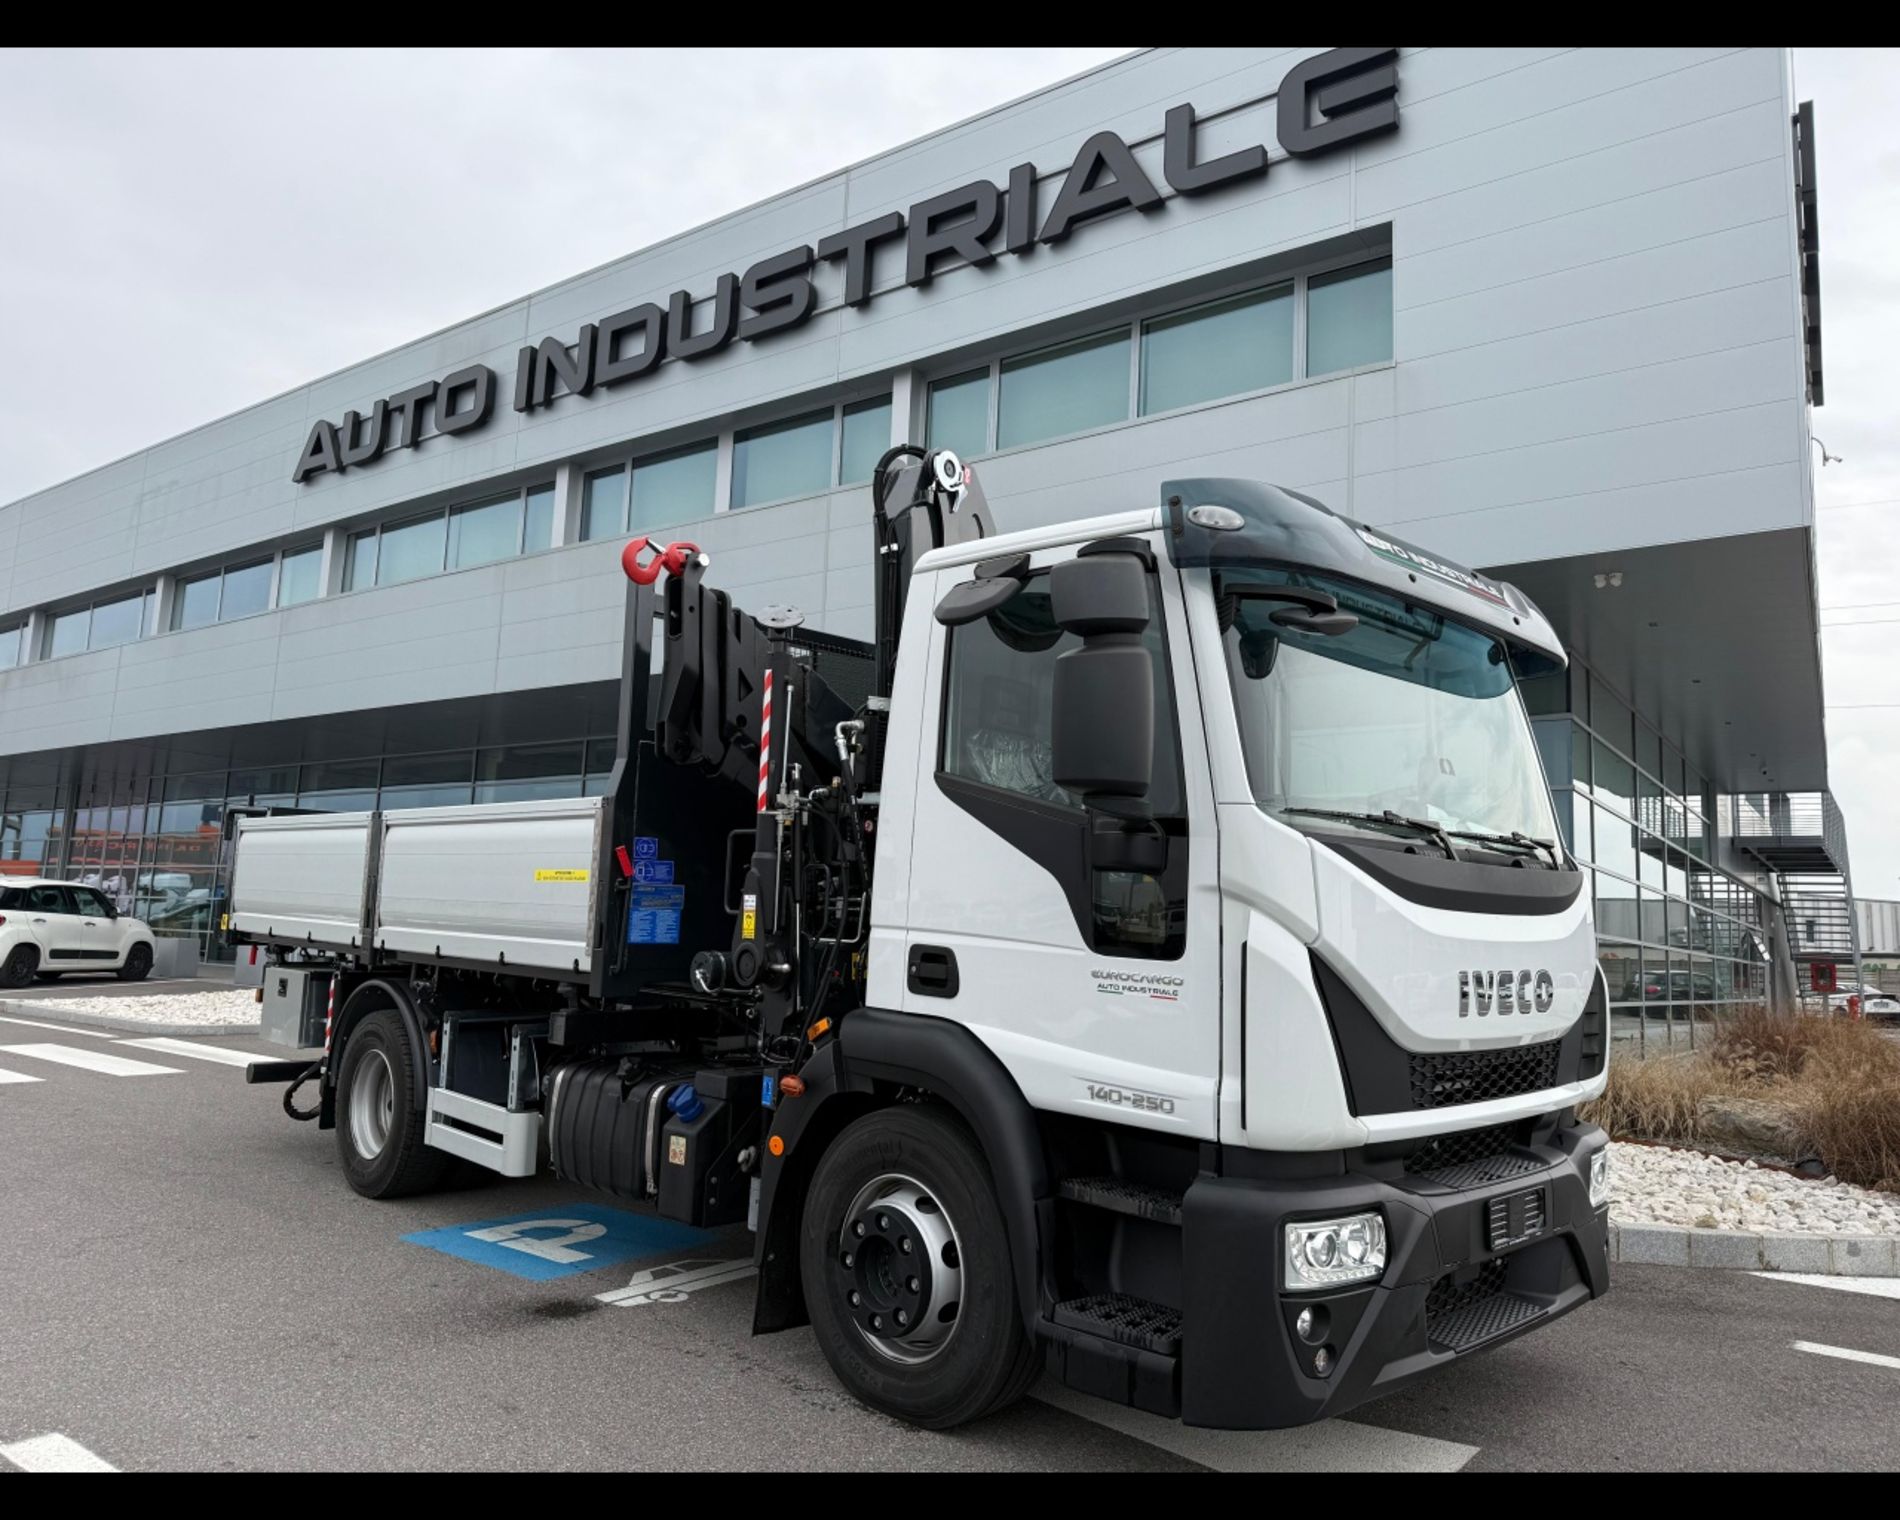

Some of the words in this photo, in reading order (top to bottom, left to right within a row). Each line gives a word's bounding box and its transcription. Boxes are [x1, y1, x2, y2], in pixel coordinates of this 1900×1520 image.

[293, 363, 496, 483] AUTO
[514, 47, 1400, 412] INDUSTRIALE
[1091, 969, 1184, 987] EUROCARGO
[1097, 983, 1120, 991] AUTO
[1122, 985, 1179, 997] INDUSTRIALE
[1458, 969, 1554, 1018] IVECO
[1087, 1084, 1175, 1115] 140-250
